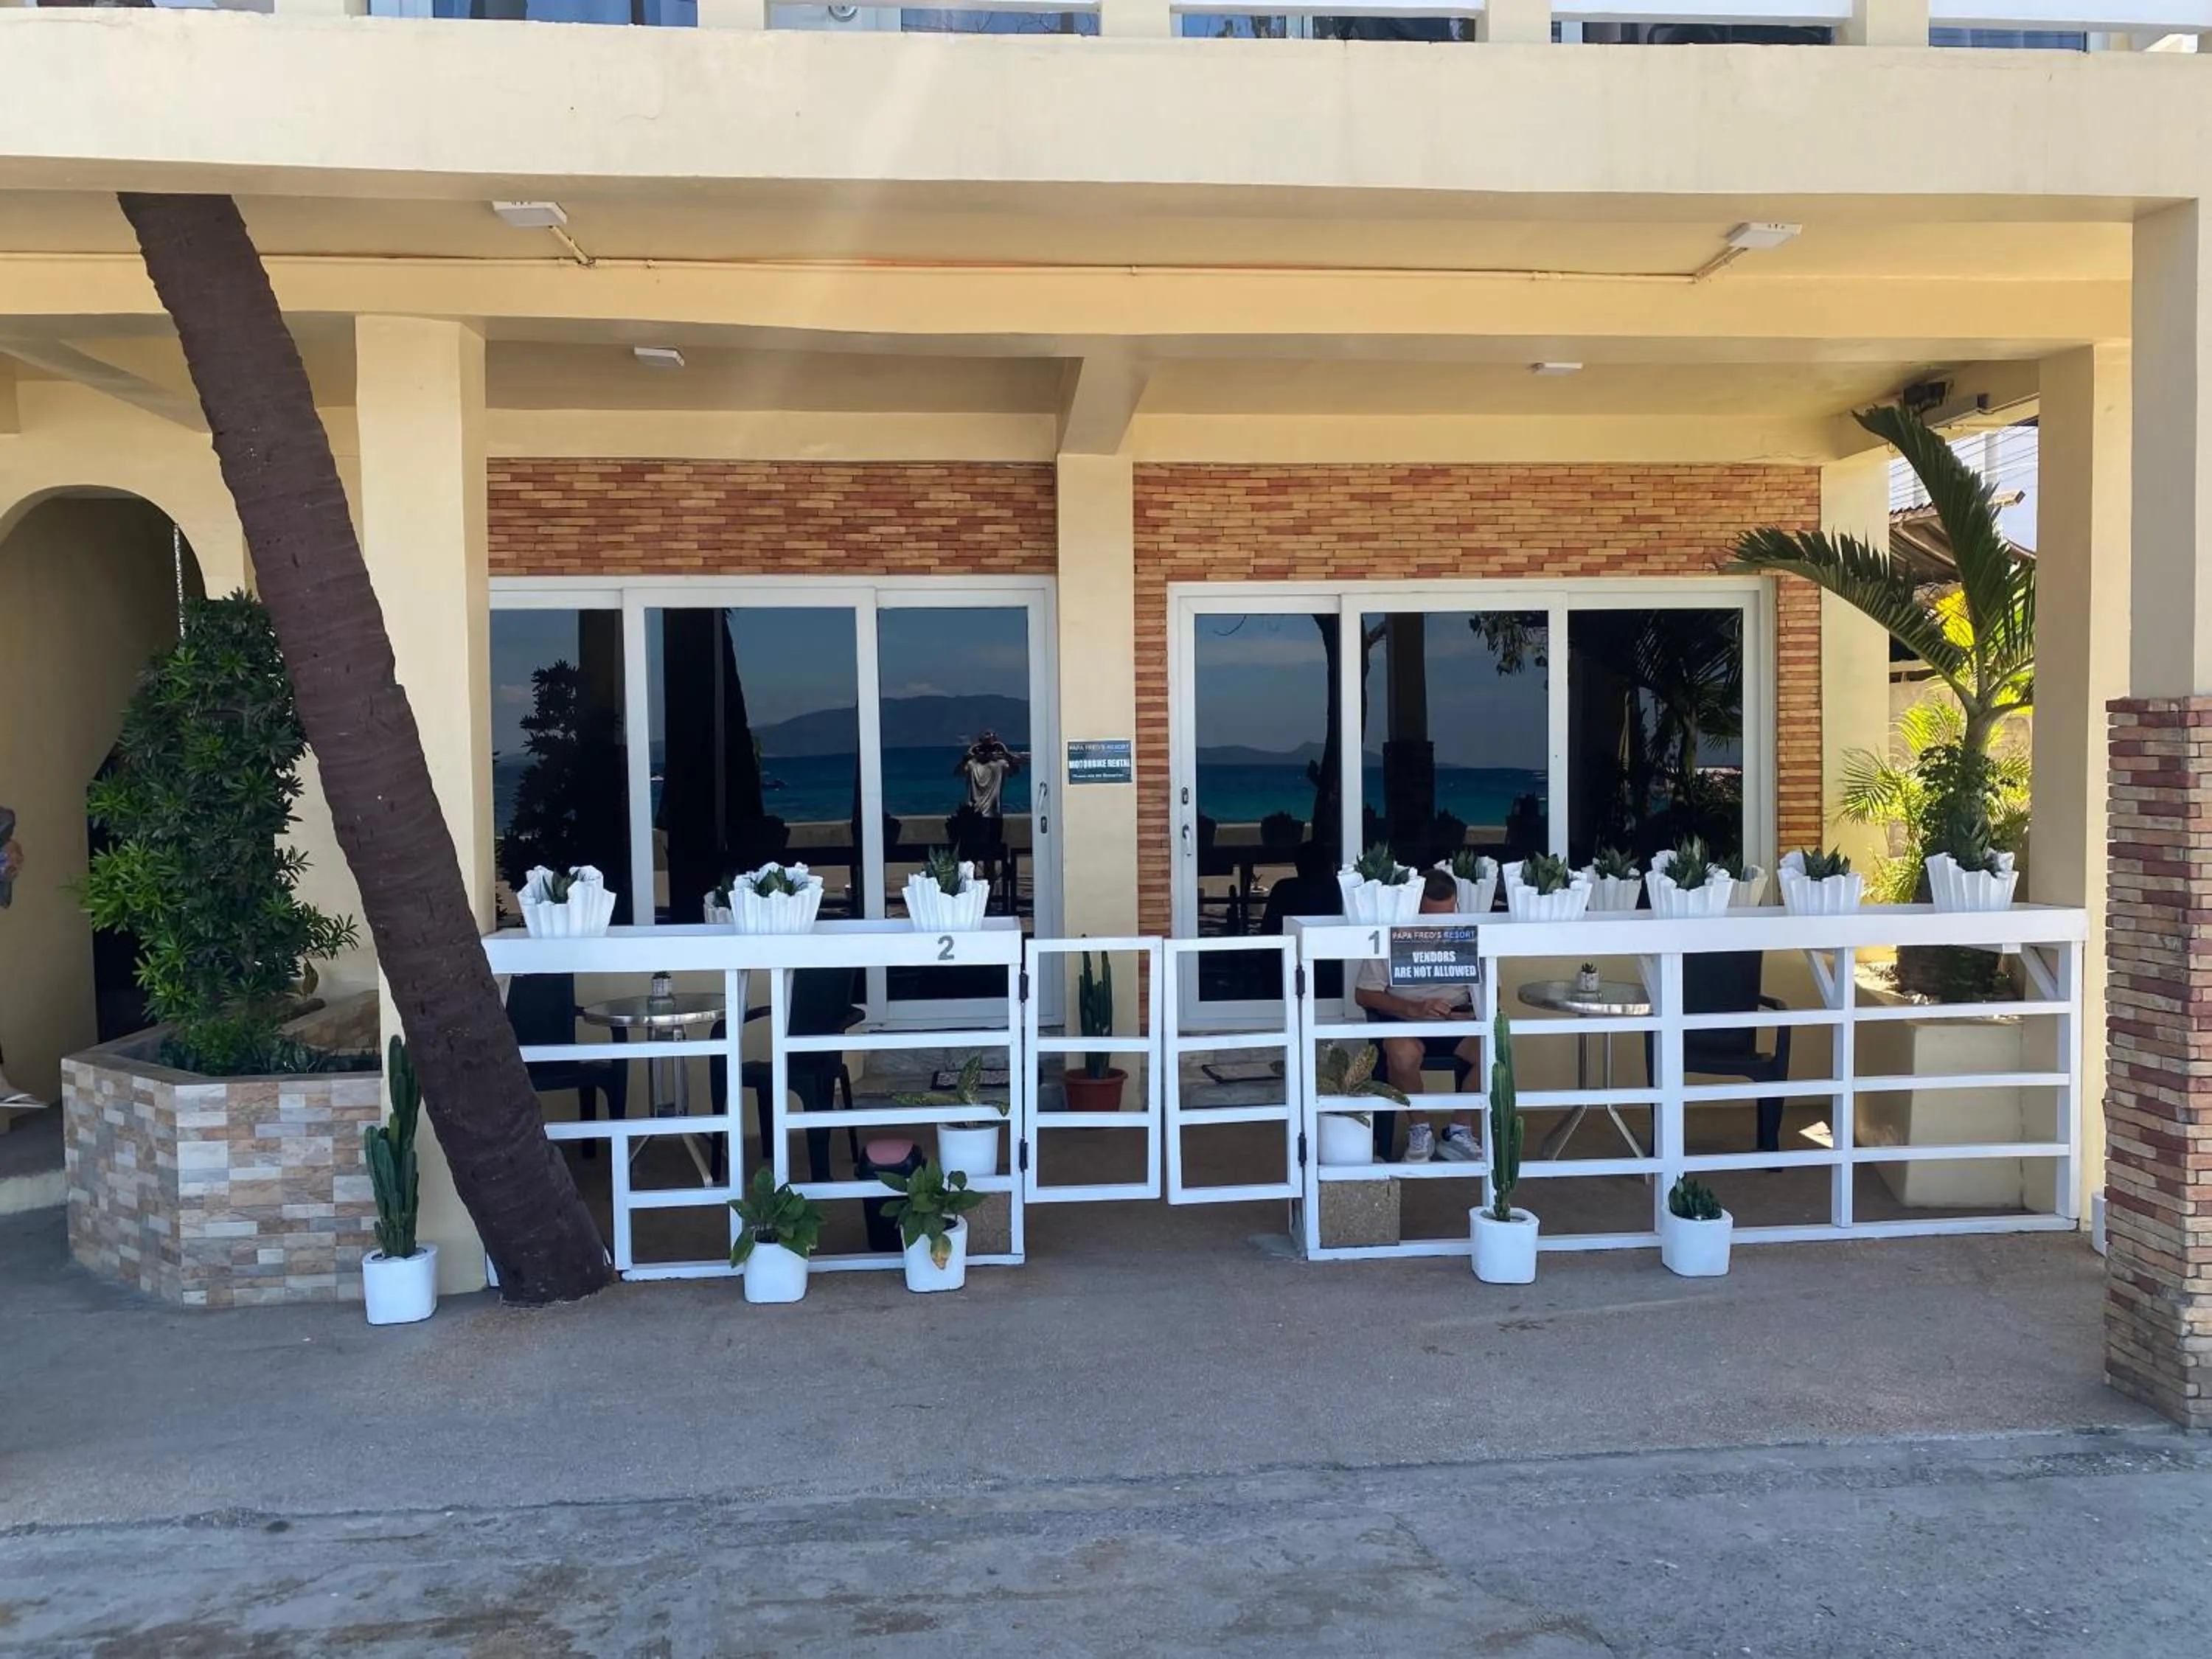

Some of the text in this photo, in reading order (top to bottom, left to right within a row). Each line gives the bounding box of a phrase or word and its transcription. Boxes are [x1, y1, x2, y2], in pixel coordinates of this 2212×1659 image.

[1443, 931, 1475, 939] RESORT
[938, 935, 954, 960] 2
[1368, 931, 1380, 955] 1
[1413, 951, 1456, 962] VENDORS
[1394, 965, 1477, 978] ARE NOT ALLOWED
